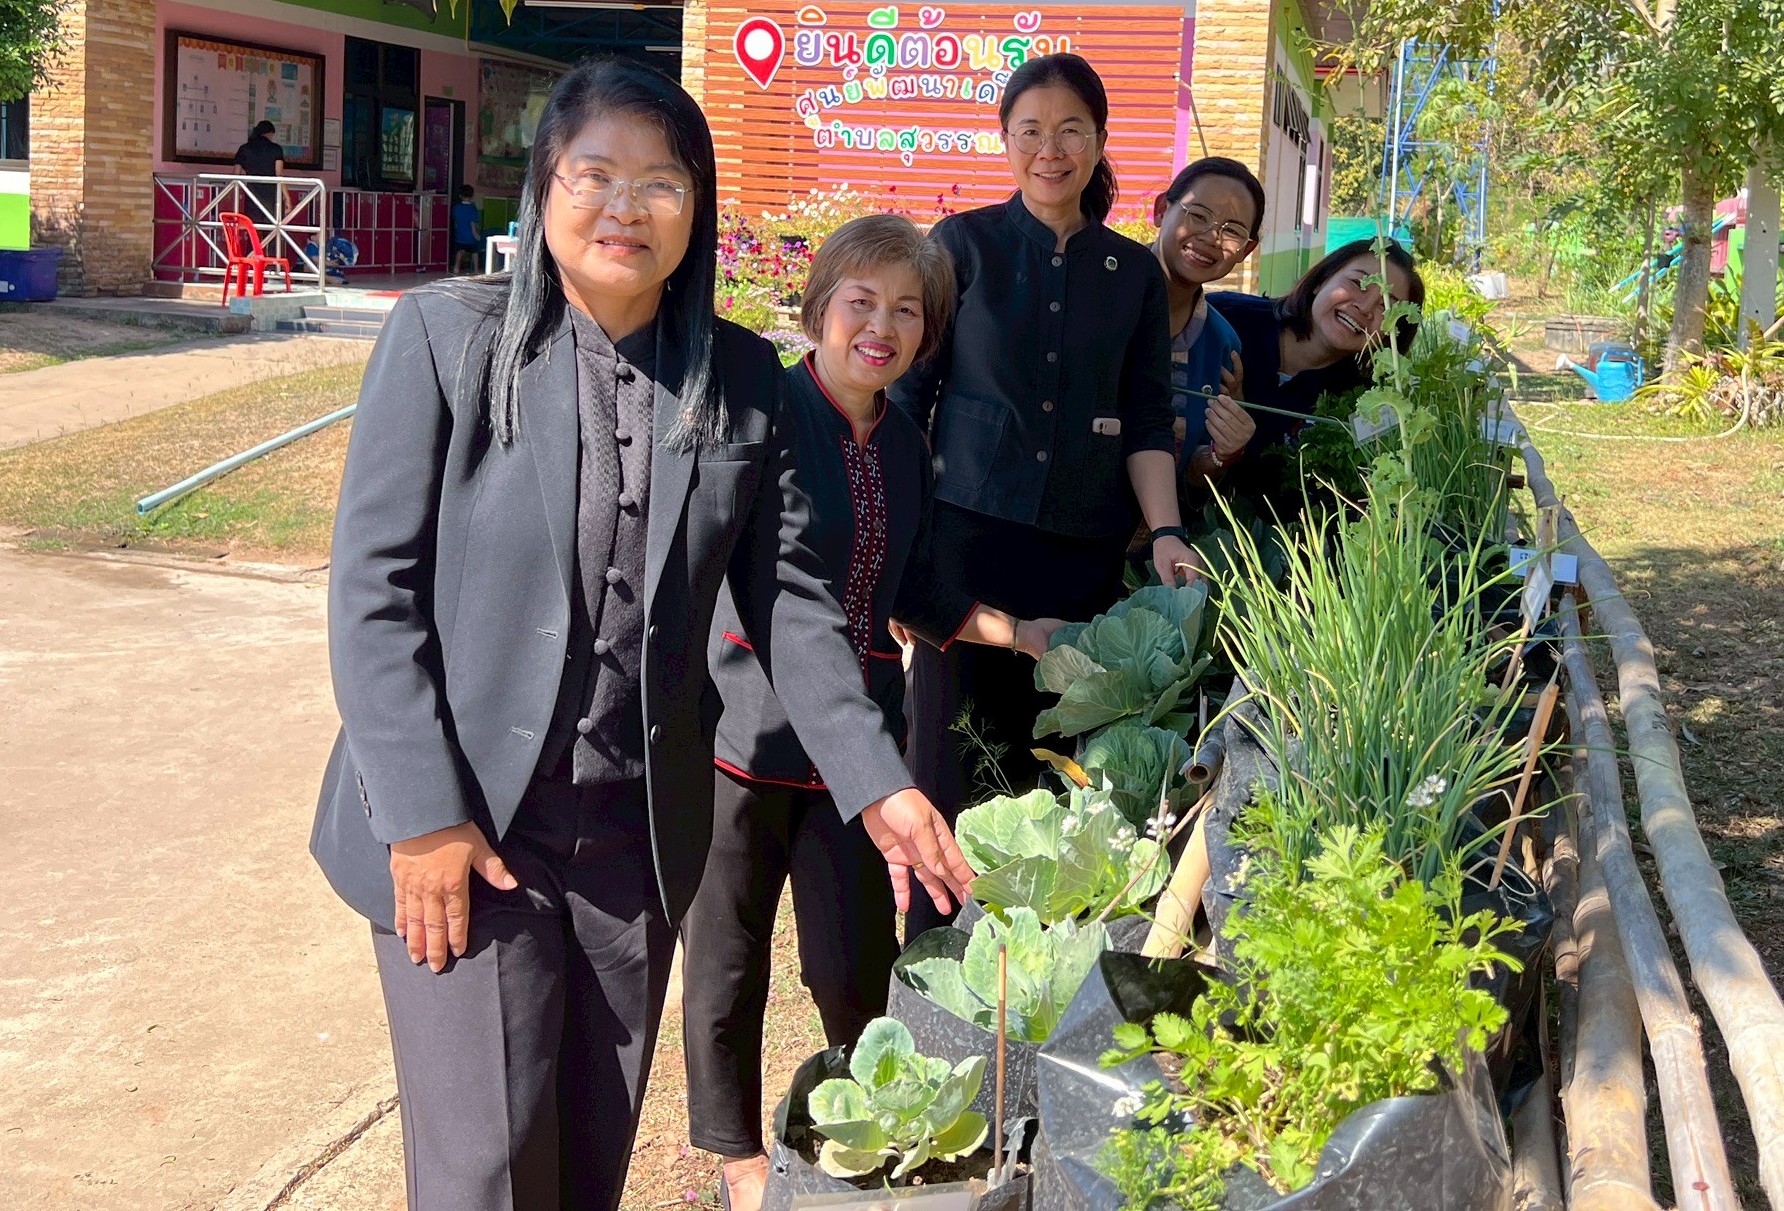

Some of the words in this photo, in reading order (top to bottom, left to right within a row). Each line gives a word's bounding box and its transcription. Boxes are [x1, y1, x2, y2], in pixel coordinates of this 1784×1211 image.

[798, 64, 1010, 128] ศูนย์พัฒนาเด็
[816, 121, 1004, 164] ตำบลสุวรรณ
